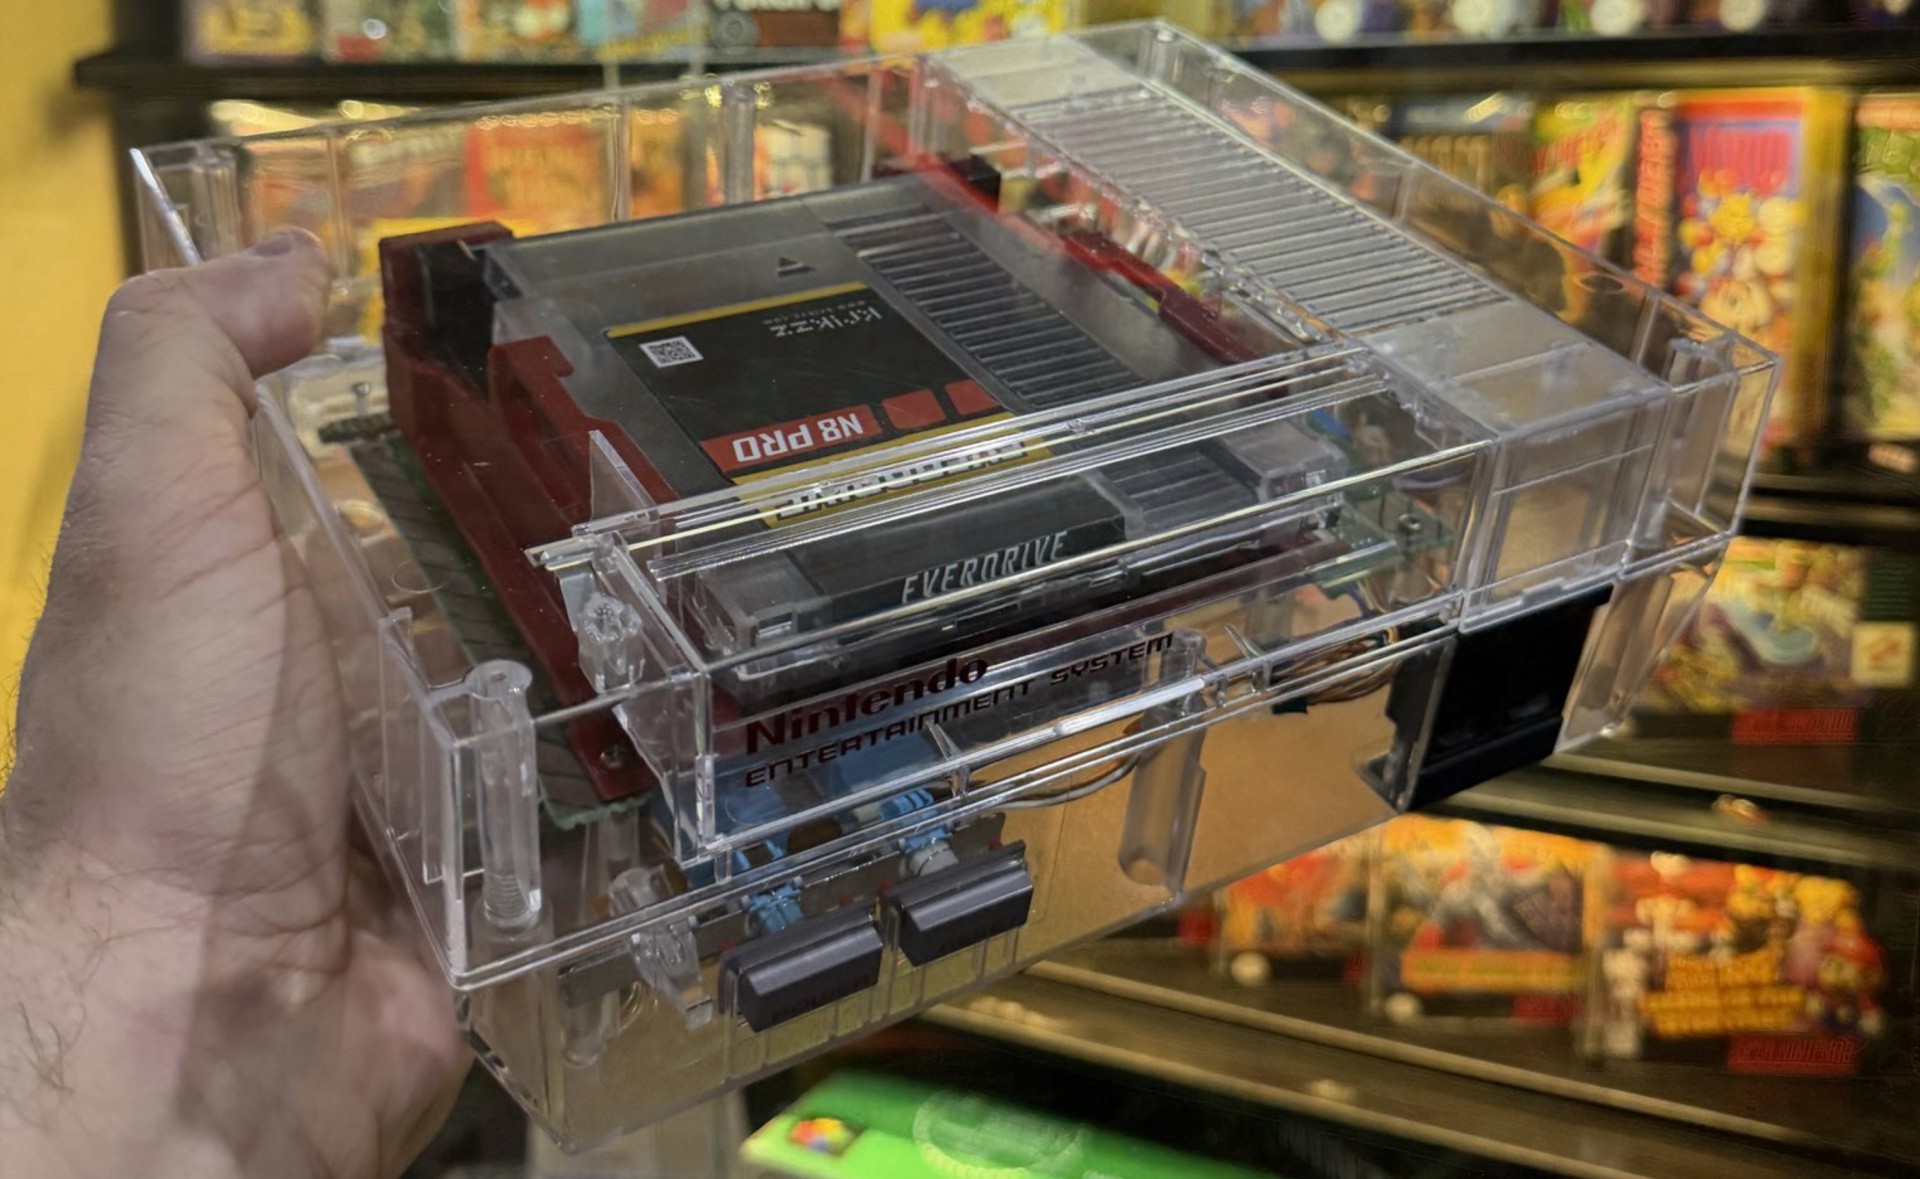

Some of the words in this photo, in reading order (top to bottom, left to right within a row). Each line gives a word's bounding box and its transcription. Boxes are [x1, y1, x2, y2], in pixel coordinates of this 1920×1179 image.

[732, 424, 814, 462] PRO
[817, 413, 864, 442] N8
[902, 530, 1068, 604] EVERDRIVE
[746, 657, 988, 755] Nintendo
[746, 678, 1036, 788] ENTERTAINMENT
[1051, 632, 1174, 686] SYSTEM
